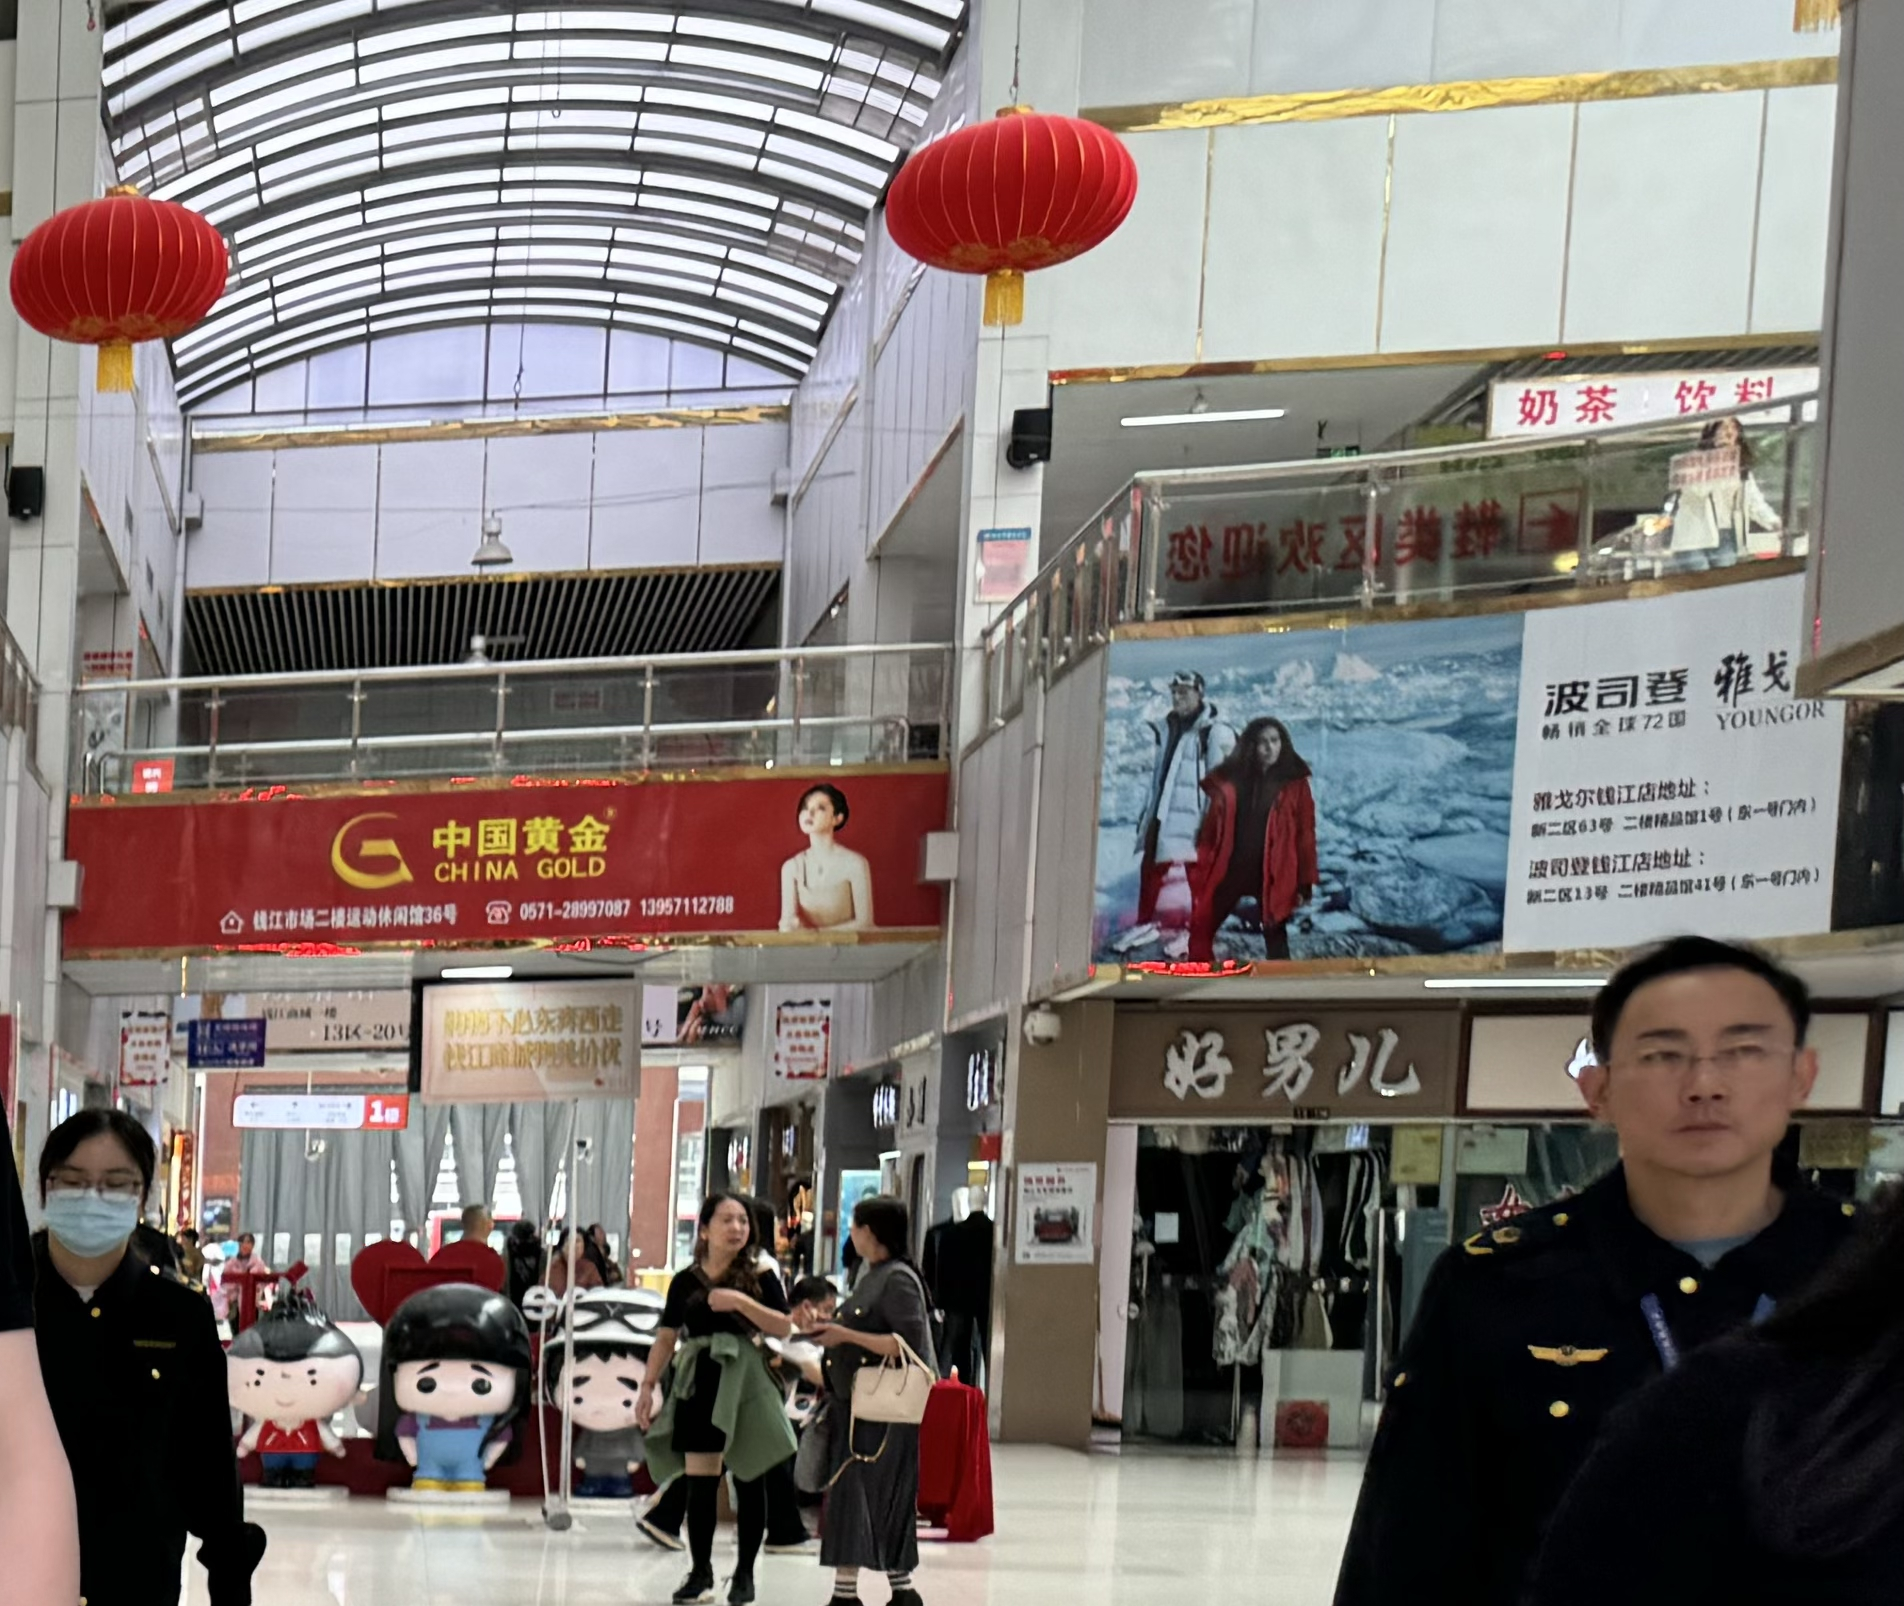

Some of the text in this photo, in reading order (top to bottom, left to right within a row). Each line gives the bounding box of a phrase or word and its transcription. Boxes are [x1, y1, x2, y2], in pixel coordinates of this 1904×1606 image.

[1517, 384, 1618, 427] 奶茶
[1543, 649, 1792, 717] 波司登 雅戈
[1716, 701, 1825, 732] YOUNGOR
[432, 814, 611, 856] 中国黄金
[433, 855, 607, 883] CHINA GOLD
[519, 898, 632, 922] 0571-28997087
[639, 894, 735, 918] 13957112788
[1163, 1021, 1423, 1103] 好男儿
